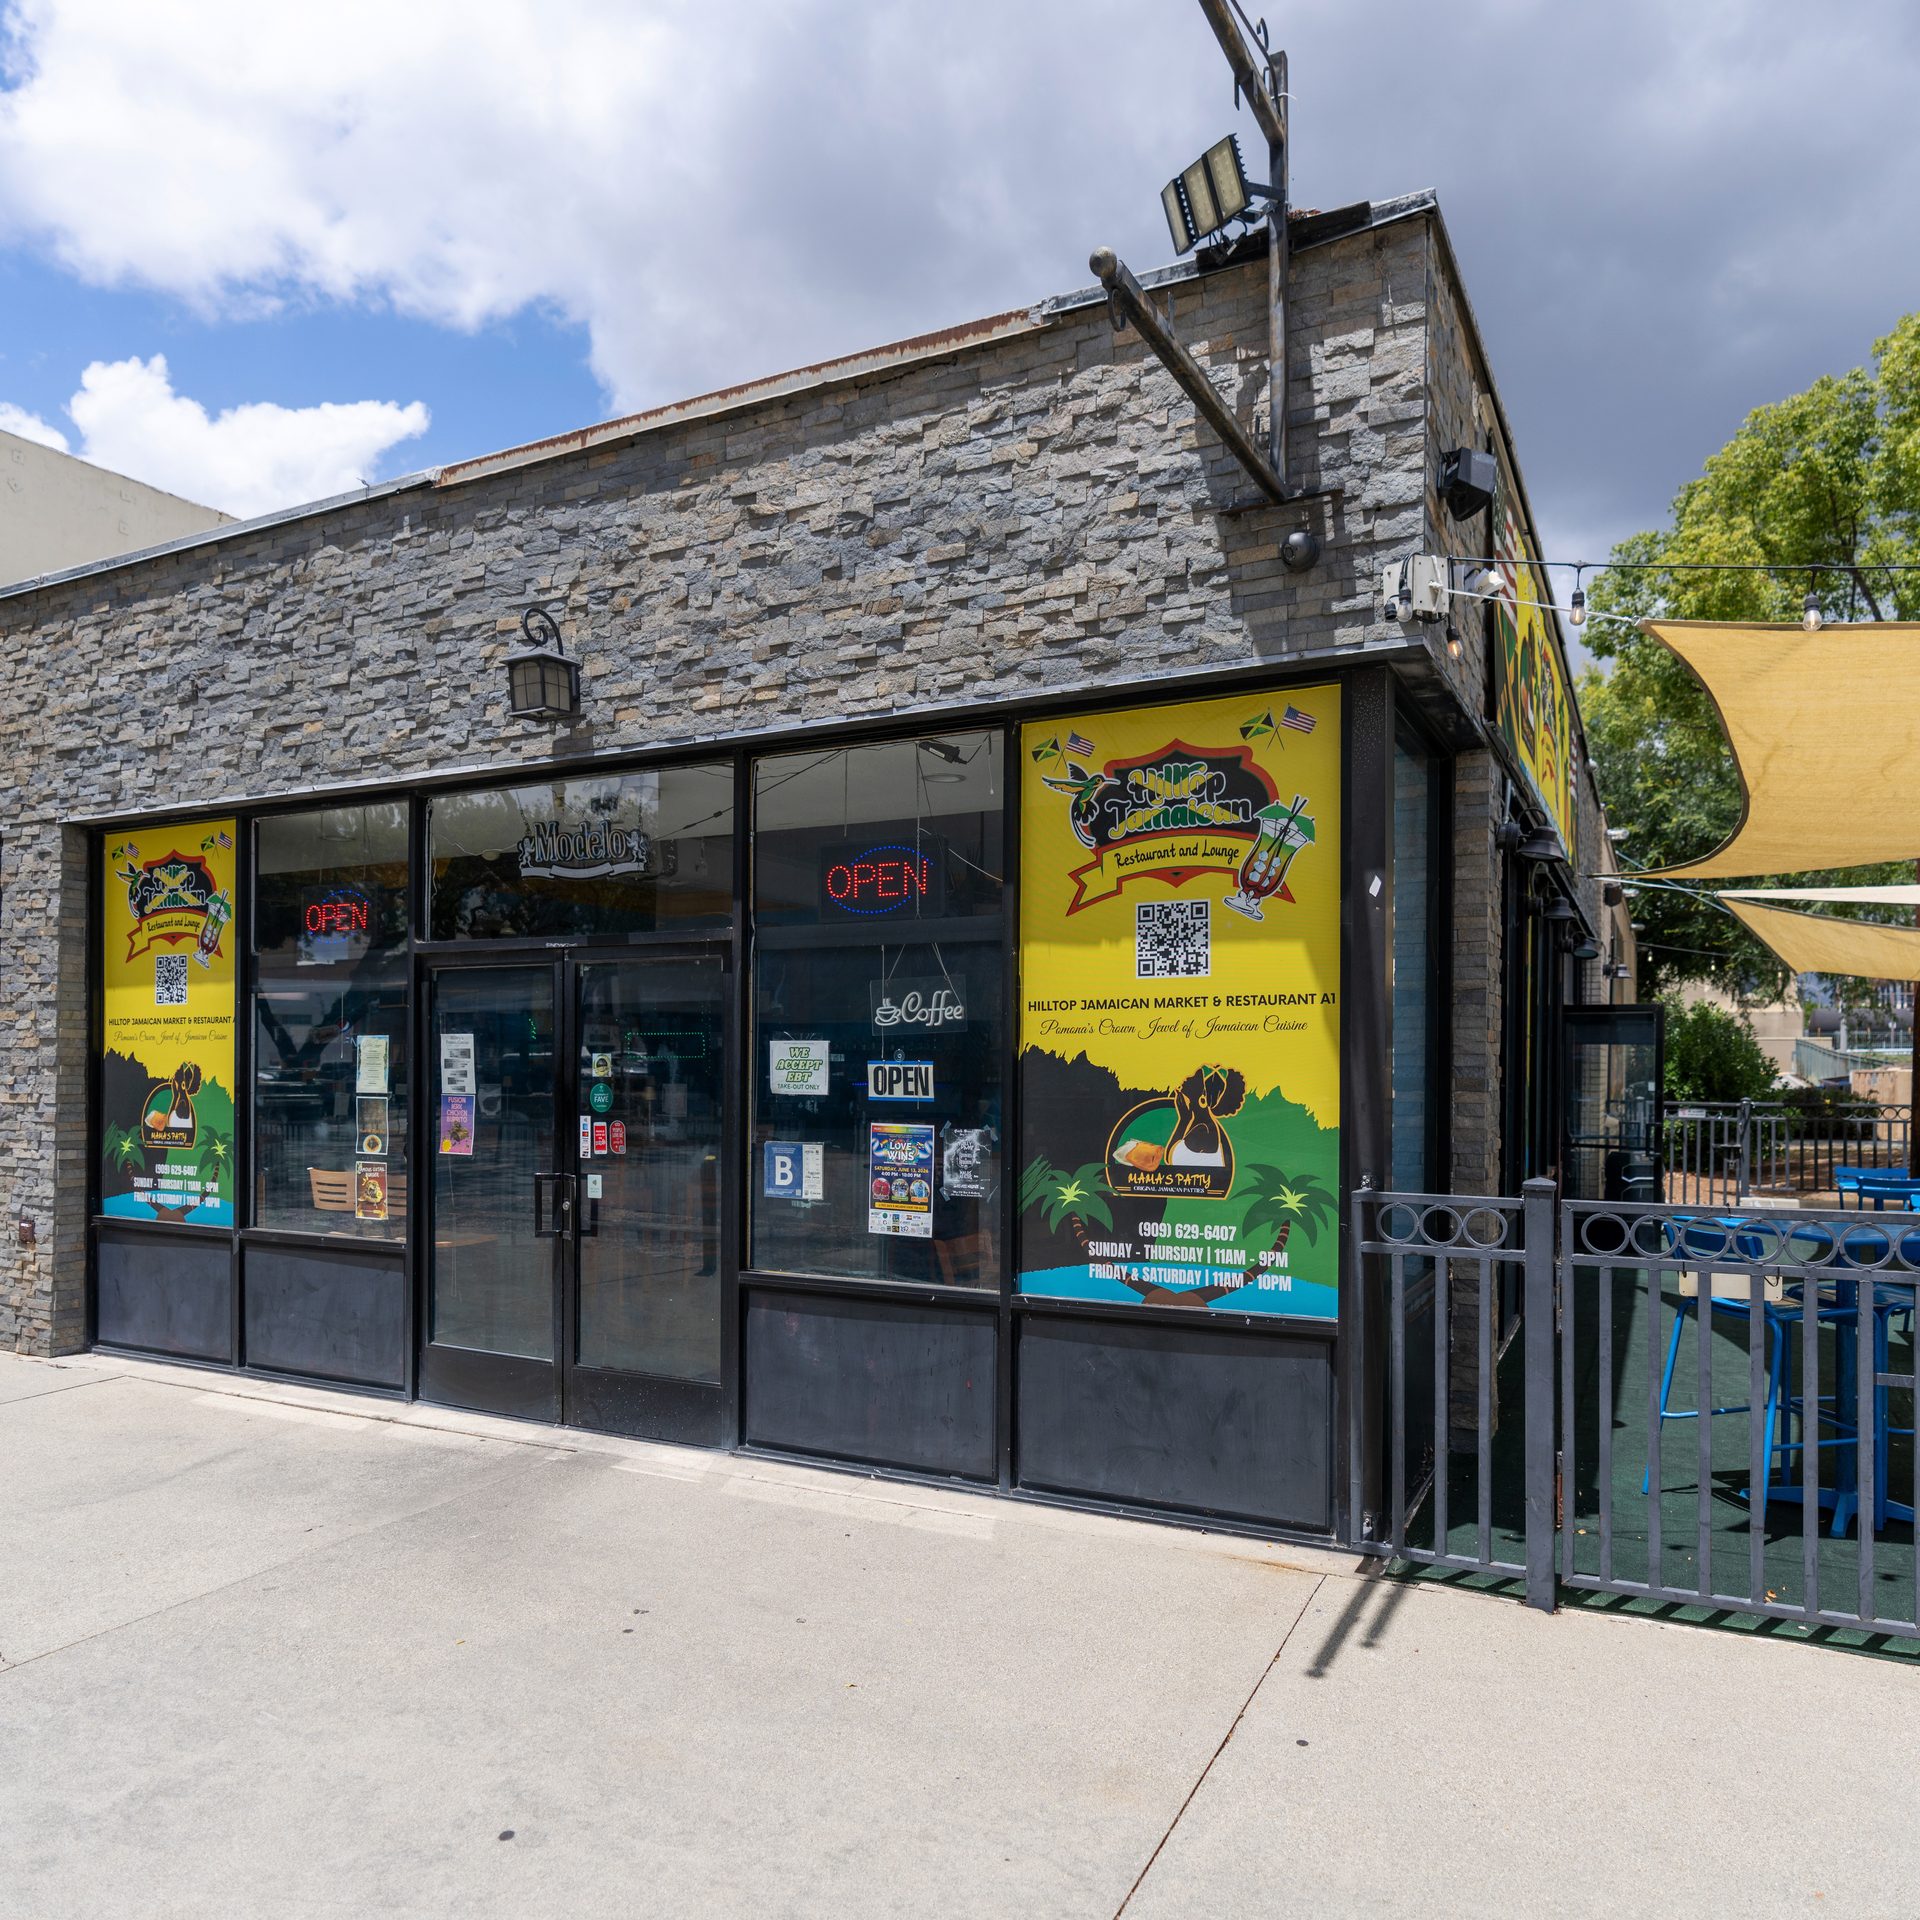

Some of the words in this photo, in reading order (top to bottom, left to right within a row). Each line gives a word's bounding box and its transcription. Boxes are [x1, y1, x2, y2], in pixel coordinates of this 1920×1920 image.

[1127, 761, 1226, 806] Hilltop
[1104, 798, 1252, 839] Jamaican
[534, 819, 627, 863] Modelo
[1114, 843, 1176, 868] Restaurant
[1179, 842, 1198, 858] and
[1202, 839, 1239, 865] Lounge
[827, 859, 928, 899] OPEN
[147, 917, 173, 931] Restaurant
[184, 915, 200, 932] Lounge
[305, 901, 369, 932] OPEN
[901, 991, 965, 1026] Coffee
[1028, 1000, 1077, 1011] HILLTOP
[1080, 998, 1150, 1010] JAMAICAN
[1154, 997, 1208, 1009] MARKET
[1212, 996, 1221, 1007] &
[1226, 993, 1317, 1006] RESTAURANT
[1320, 993, 1336, 1005] A1
[108, 1018, 130, 1026] HILLTOP
[132, 1017, 162, 1026] JAMAICAN
[163, 1016, 187, 1025] MARKET
[194, 1016, 231, 1024] RESTAURANT
[1040, 1019, 1095, 1036] Pomona's
[1099, 1018, 1136, 1036] Crown
[1138, 1017, 1180, 1040] Jewel
[1182, 1019, 1194, 1038] of
[1194, 1016, 1259, 1039] Jamaican
[1263, 1015, 1308, 1033] Cuisine
[776, 1059, 823, 1070] ACCEPT
[789, 1046, 810, 1058] WE
[786, 1071, 812, 1082] EBT
[873, 1066, 930, 1096] OPEN
[888, 1150, 914, 1161] WINS
[889, 1141, 912, 1150] LOVE
[775, 1155, 793, 1185] B
[1128, 1172, 1174, 1185] MAMA'S
[1175, 1172, 1211, 1189] PATTY
[1138, 1221, 1171, 1238] (909)
[1175, 1223, 1237, 1241] 629-6407
[1088, 1241, 1132, 1258] SUNDAY
[1144, 1244, 1203, 1262] THURSDAY
[1214, 1248, 1246, 1265] 11AM
[1258, 1250, 1288, 1268] 9PM
[1089, 1263, 1128, 1280] FRIDAY
[1130, 1267, 1139, 1281] &
[1142, 1266, 1202, 1285] SATURDAY
[1212, 1271, 1244, 1288] 11AM
[1257, 1274, 1292, 1292] 10PM
